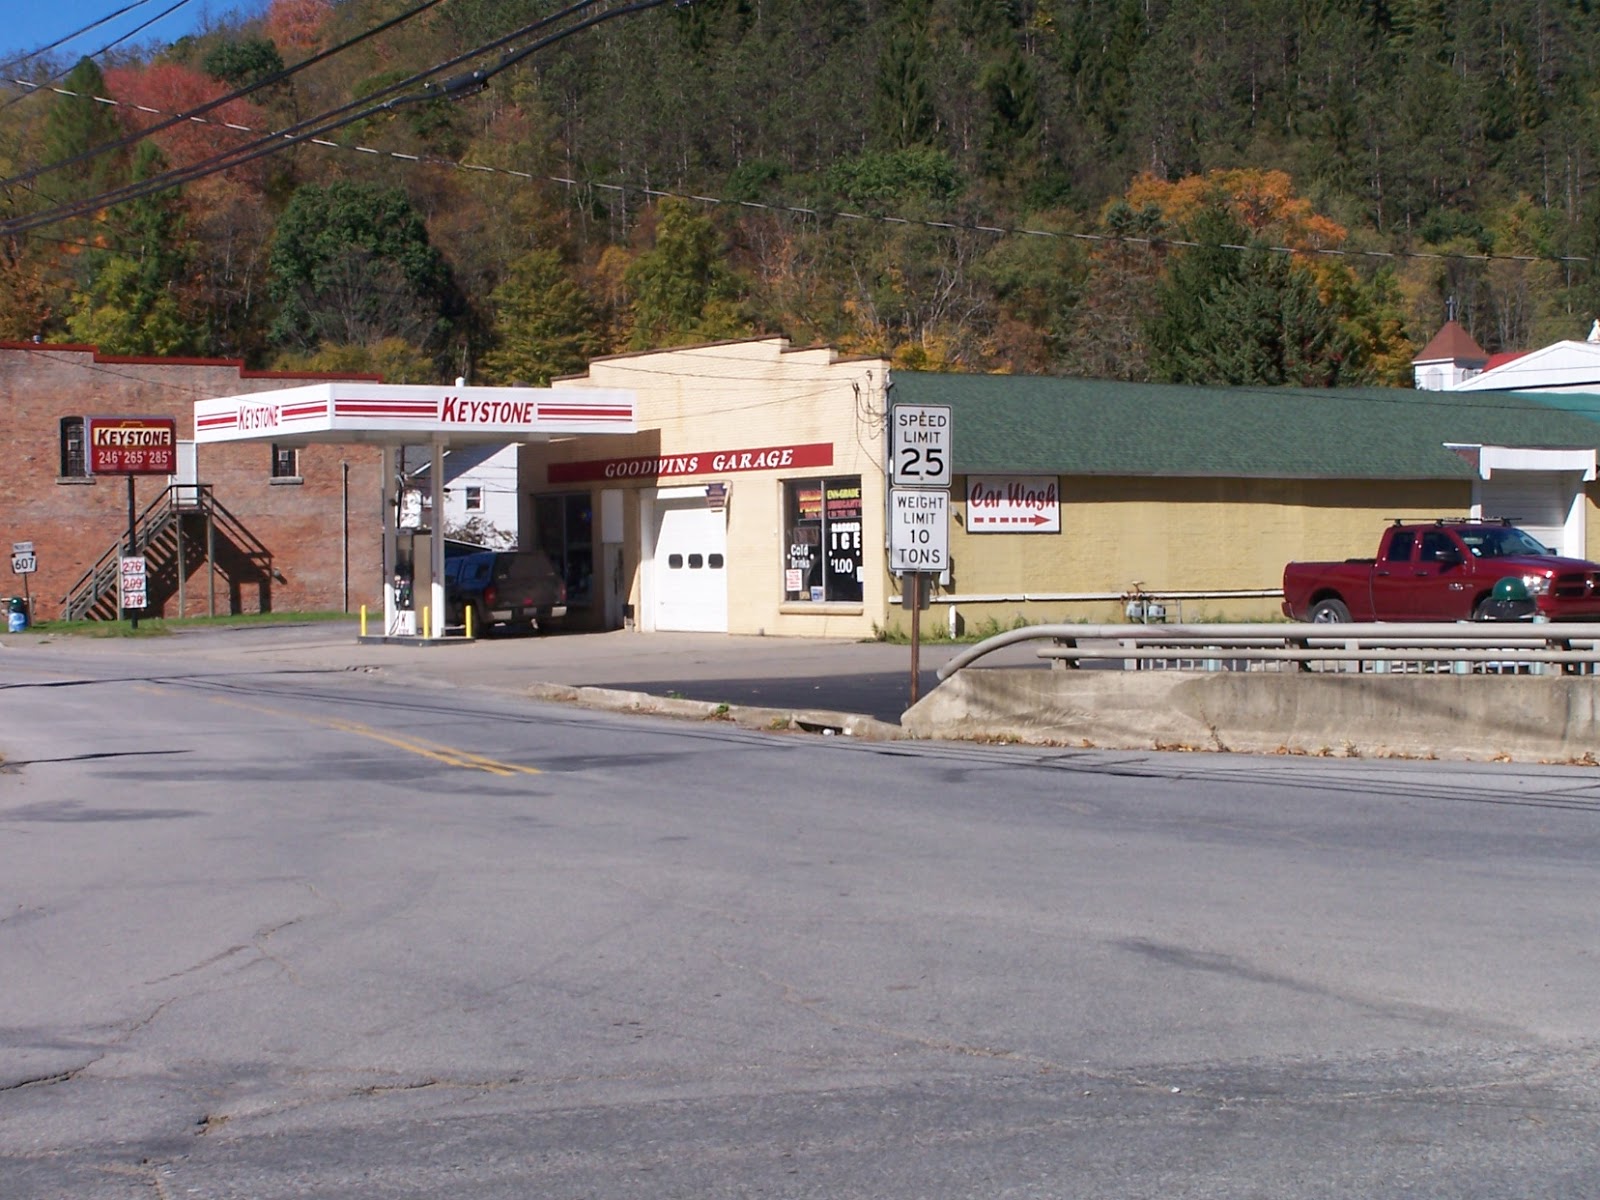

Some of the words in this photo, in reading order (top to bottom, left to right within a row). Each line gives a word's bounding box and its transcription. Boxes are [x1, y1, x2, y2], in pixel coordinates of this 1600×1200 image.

[441, 396, 534, 423] KEYSTONE
[238, 405, 280, 430] KEYSTONE
[899, 413, 947, 428] SPEED
[97, 429, 169, 446] KEYSTONE
[903, 431, 941, 444] LIMIT
[604, 456, 699, 478] GOODWINS
[712, 449, 794, 472] GARAGE
[901, 448, 944, 477] 25
[897, 496, 944, 509] WEIGHT
[970, 482, 1001, 509] Car
[1007, 482, 1056, 511] Wash
[903, 512, 936, 525] LIMIT
[832, 532, 861, 550] ICE
[910, 529, 930, 544] 10
[791, 544, 809, 556] Cold
[898, 548, 941, 564] TONS
[15, 557, 35, 571] 607
[791, 557, 810, 568] Drinks
